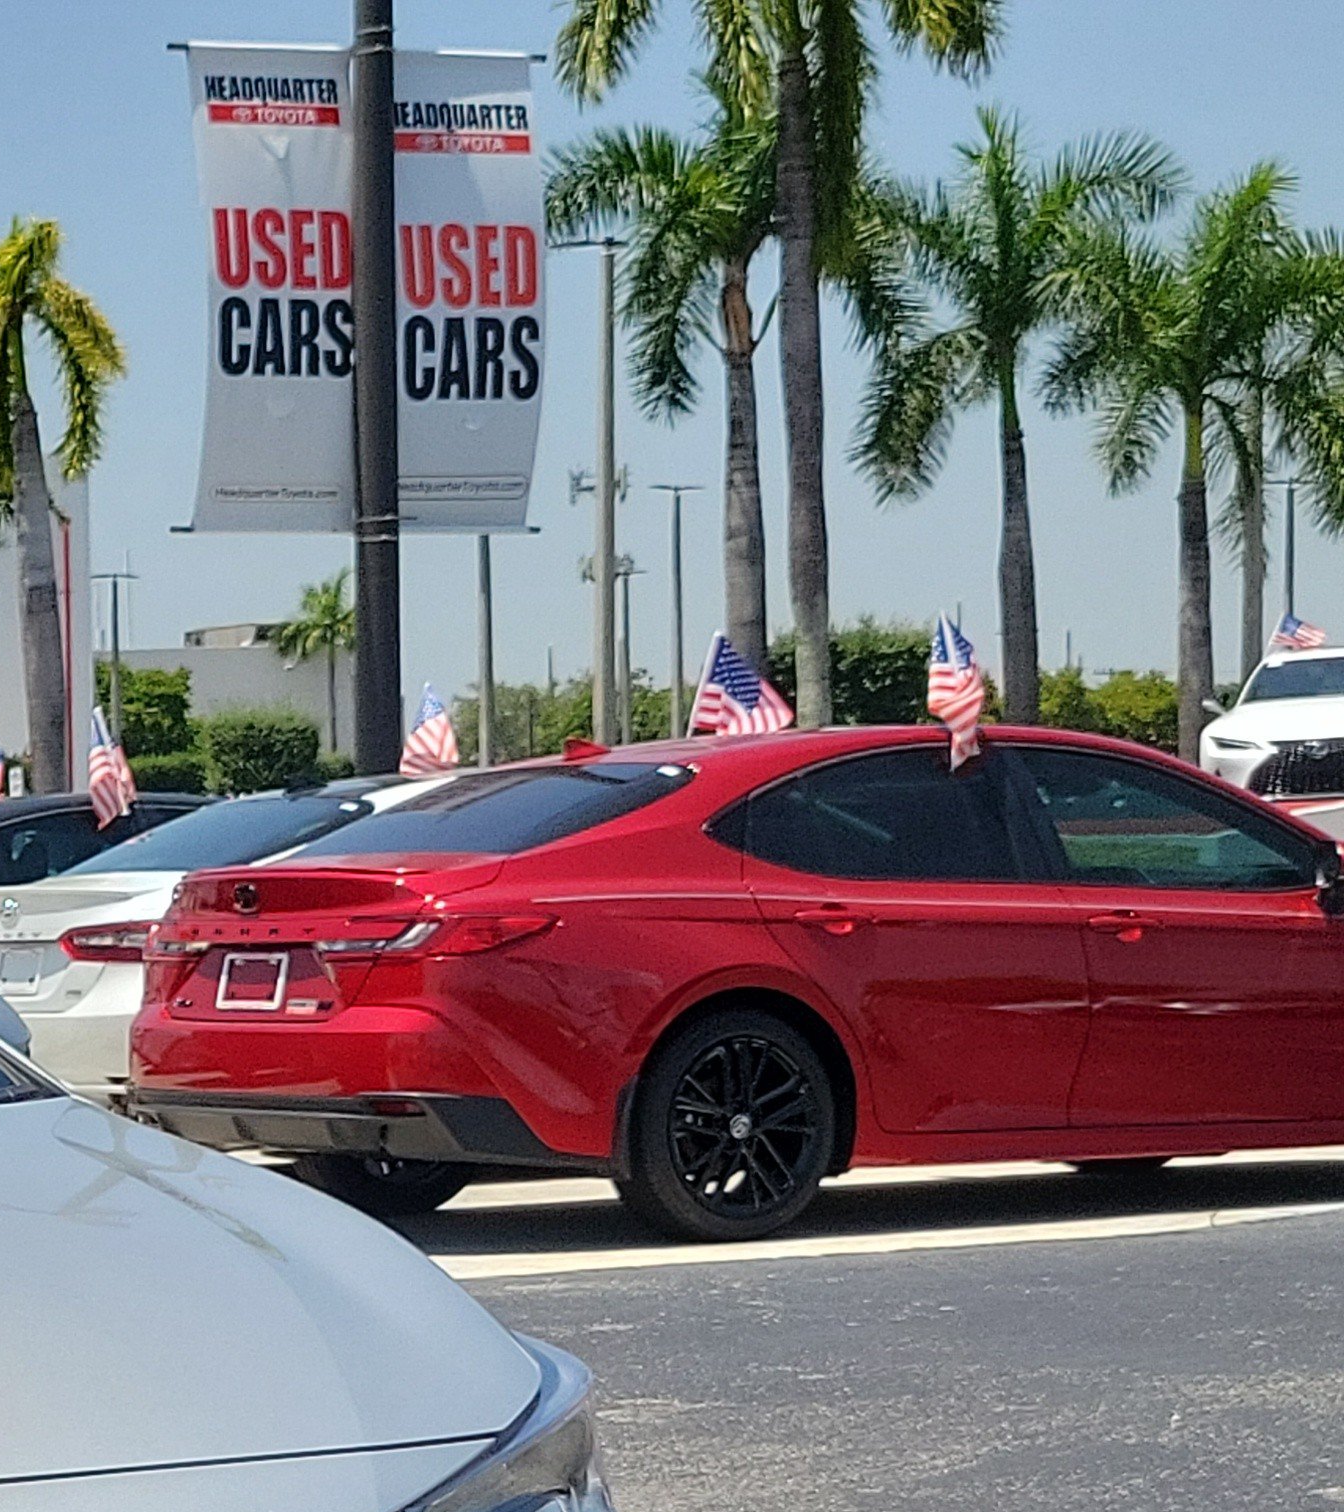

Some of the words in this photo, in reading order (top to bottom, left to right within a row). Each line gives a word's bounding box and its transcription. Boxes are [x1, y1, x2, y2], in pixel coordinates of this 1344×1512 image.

[205, 76, 338, 105] HEADQUARTER
[255, 108, 317, 124] TOYOTA
[439, 136, 506, 153] TOYOTA
[212, 208, 352, 290] USED
[400, 224, 537, 308] USED
[218, 297, 356, 377] CARS
[403, 316, 540, 400] CARS
